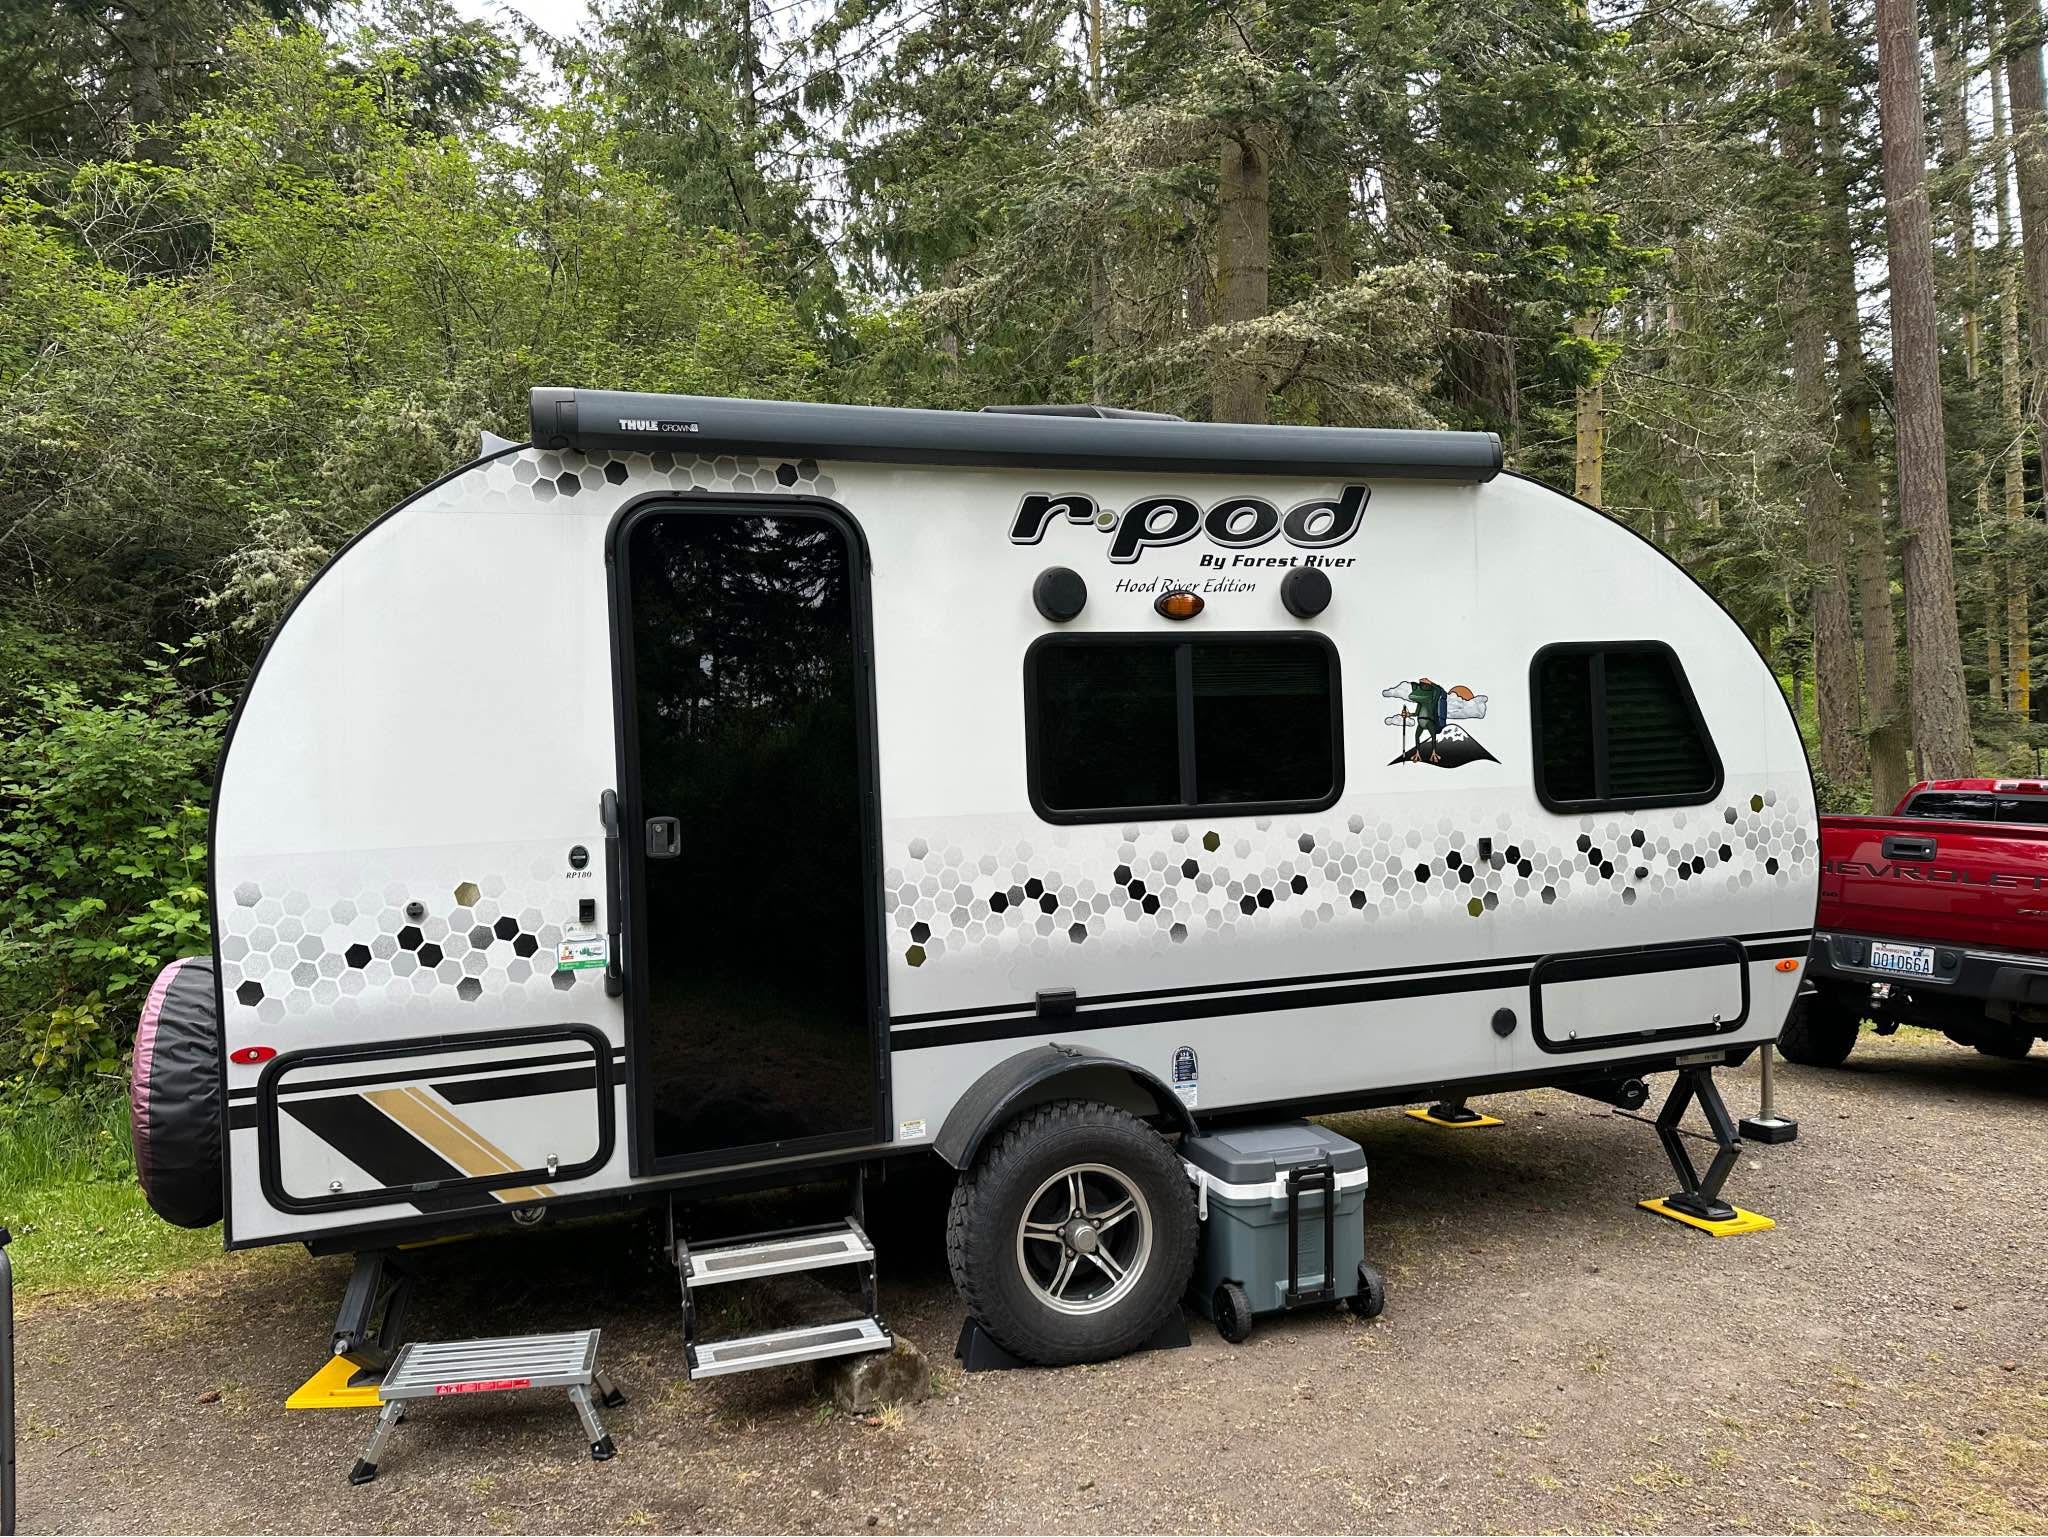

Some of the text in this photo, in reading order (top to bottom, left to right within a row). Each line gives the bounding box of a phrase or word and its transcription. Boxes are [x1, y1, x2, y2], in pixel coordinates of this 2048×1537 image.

[619, 419, 659, 431] THULE
[1199, 554, 1356, 570] By Forest River
[1115, 576, 1257, 593] Hood River Edition
